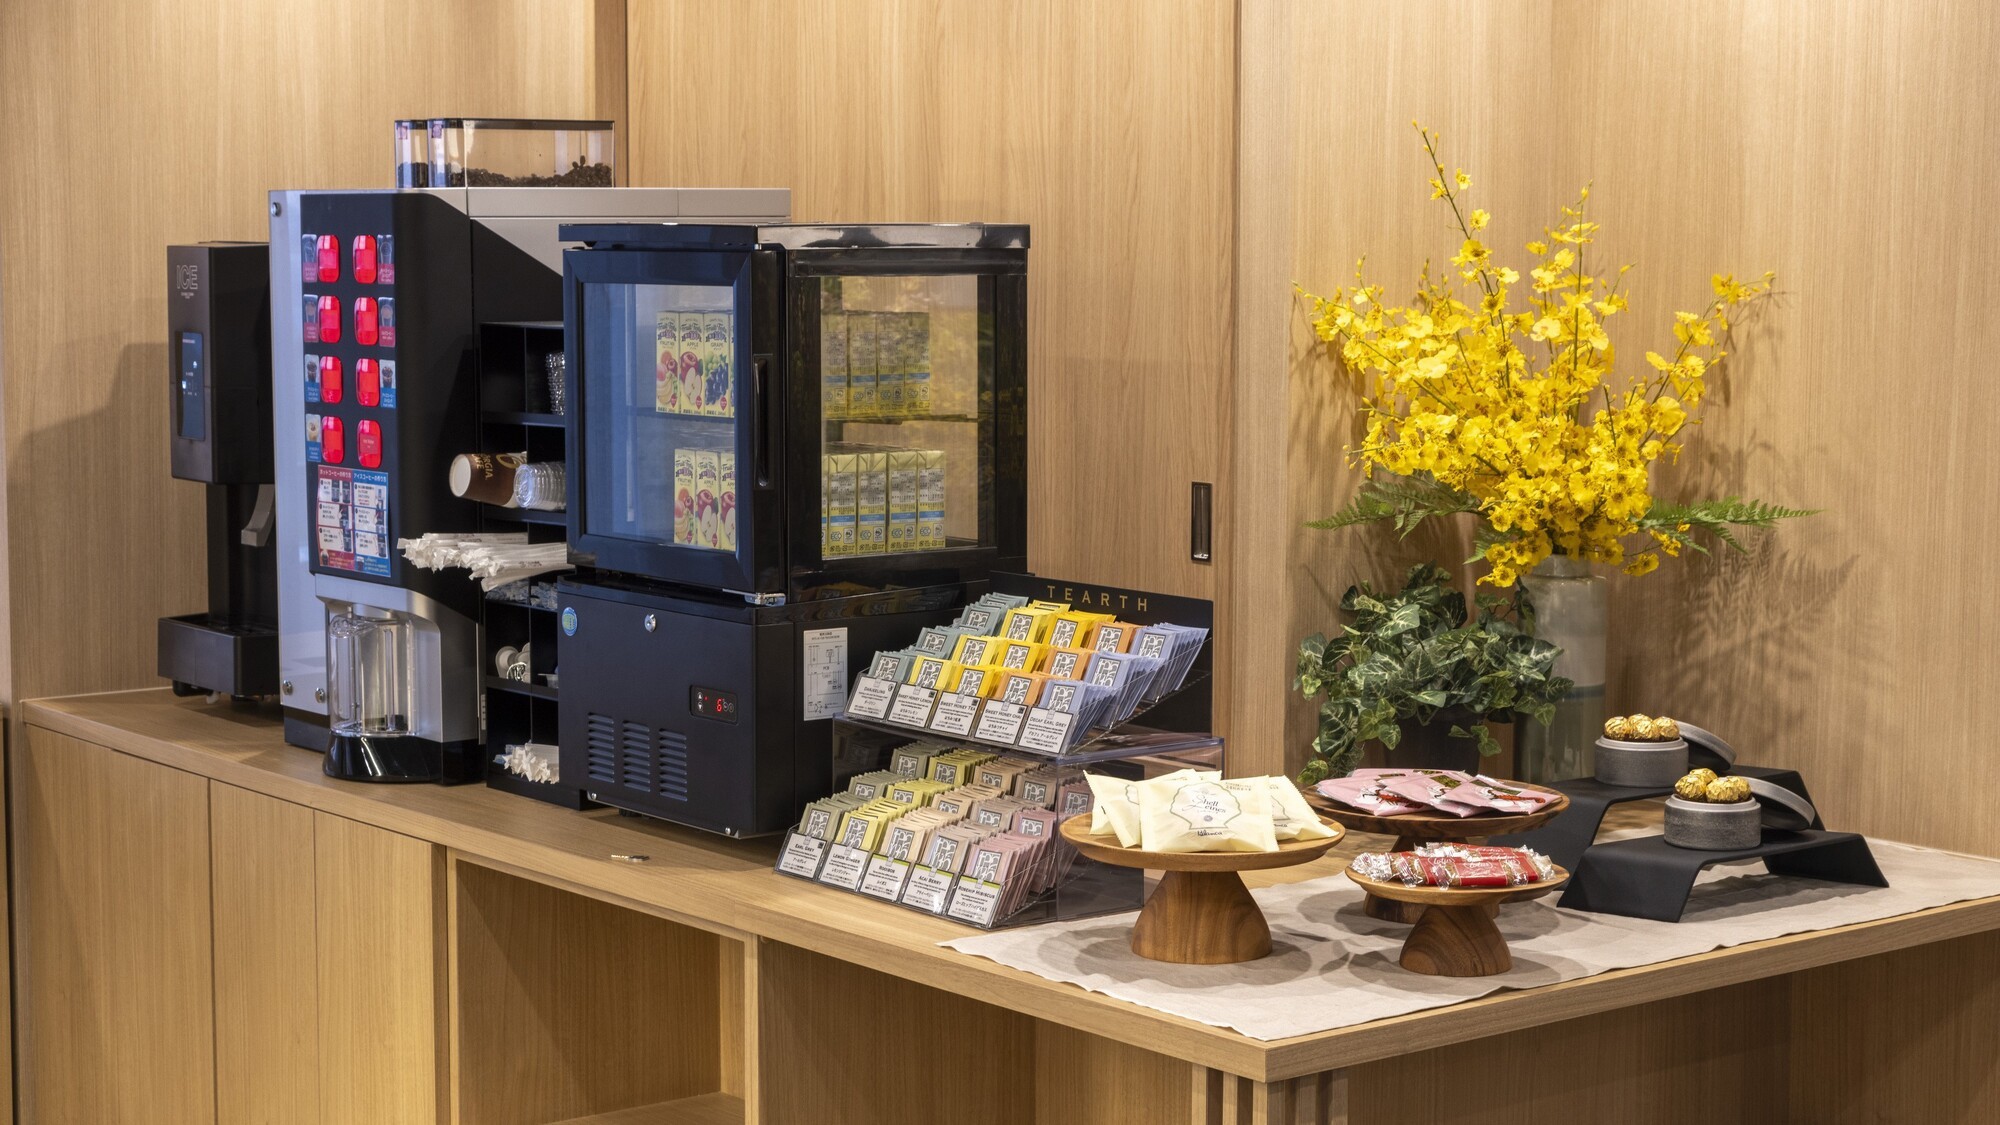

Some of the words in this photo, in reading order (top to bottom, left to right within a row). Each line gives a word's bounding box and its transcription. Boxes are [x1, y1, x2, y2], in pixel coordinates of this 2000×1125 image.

[176, 264, 198, 290] ICE
[1047, 585, 1148, 612] TEARTH
[716, 698, 722, 712] 6
[1028, 716, 1043, 724] DECAF
[1042, 718, 1055, 726] EARL
[1054, 720, 1067, 728] GREY
[1192, 794, 1219, 807] Shell
[1197, 829, 1223, 837] Blanca
[1433, 856, 1453, 865] Lotus
[927, 877, 942, 885] BERRY
[974, 889, 995, 899] HIBISCUS
